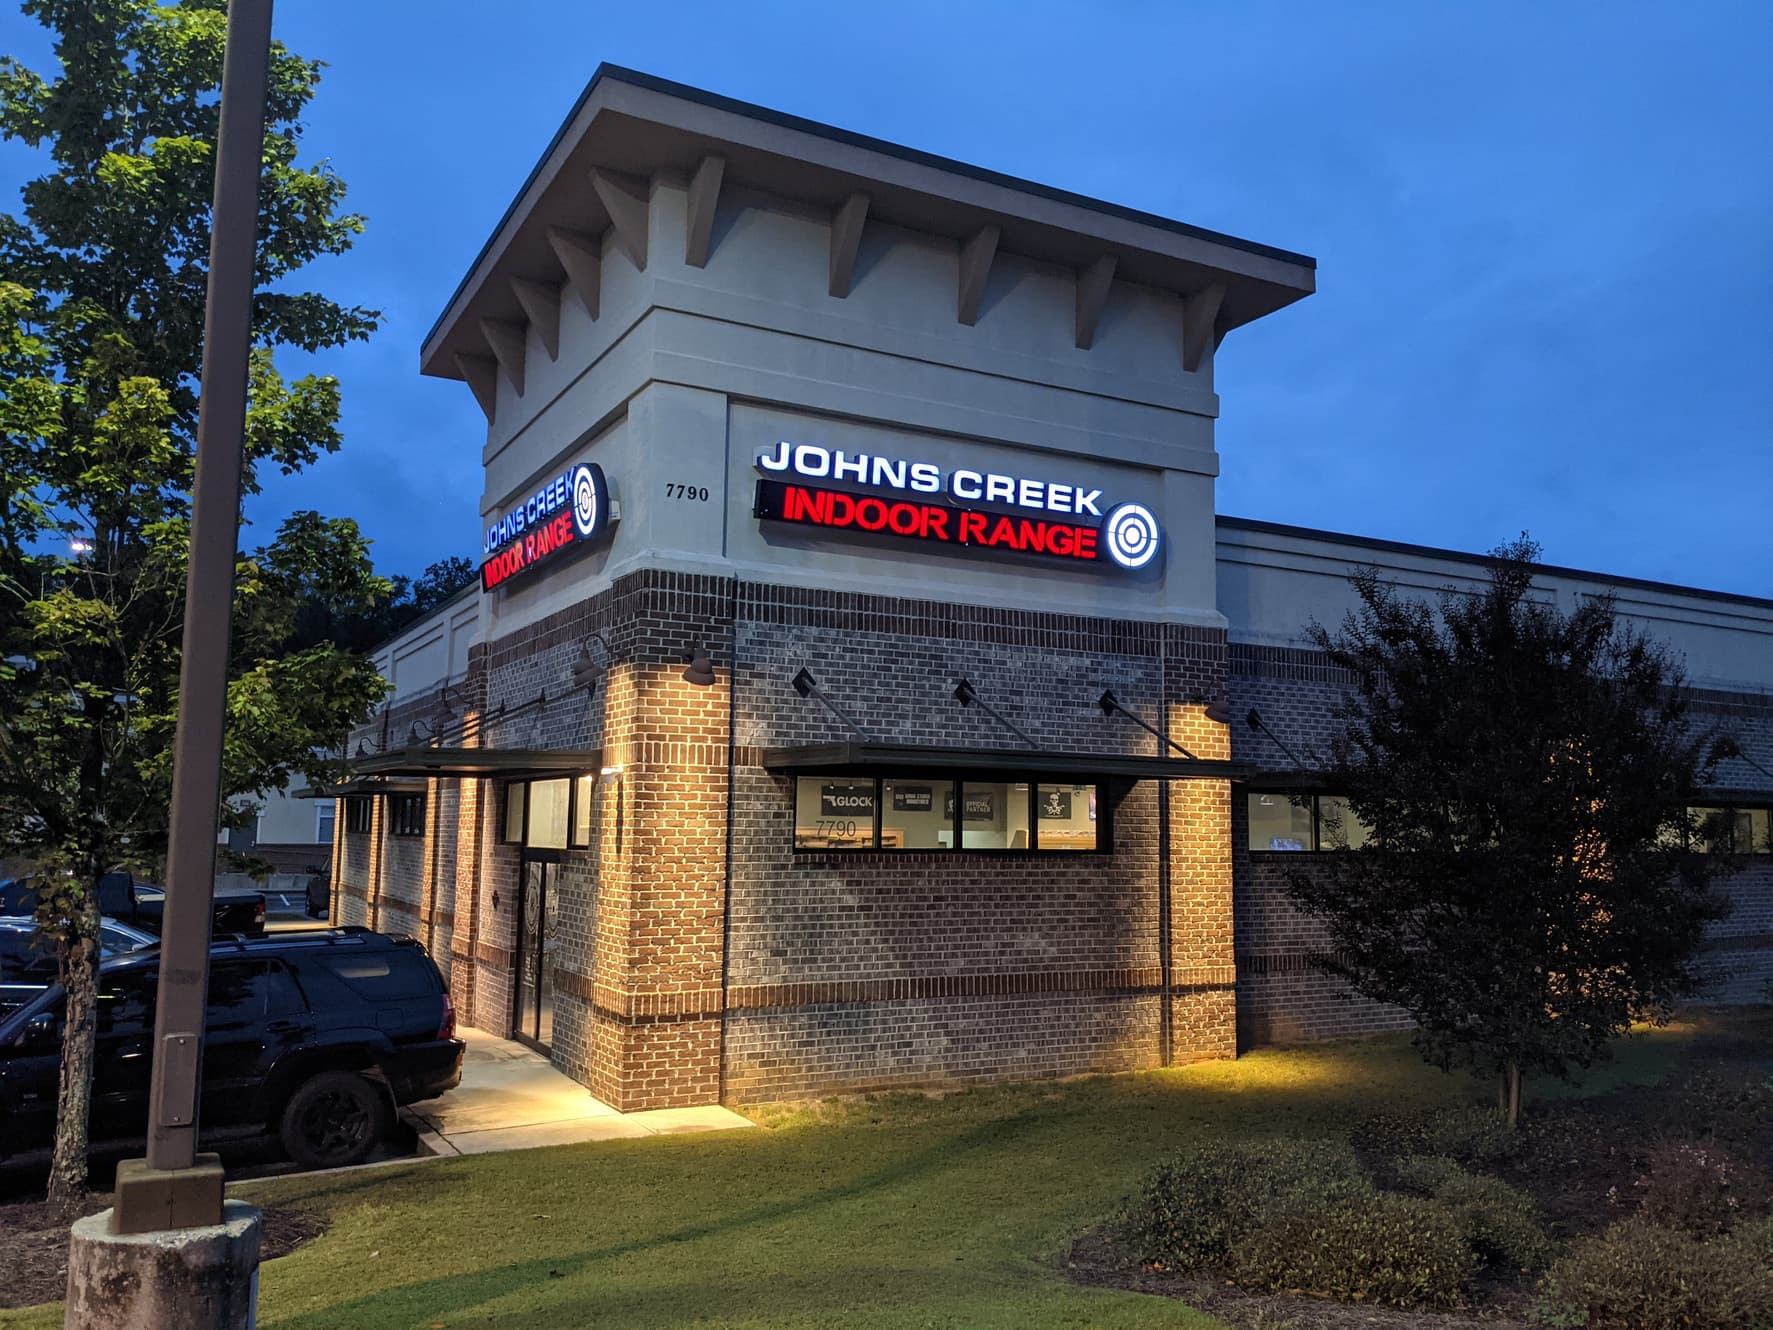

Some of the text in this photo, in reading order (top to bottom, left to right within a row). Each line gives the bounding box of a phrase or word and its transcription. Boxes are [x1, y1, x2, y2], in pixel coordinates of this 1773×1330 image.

[484, 467, 574, 554] JOHNS CREEK
[666, 483, 709, 502] 7790
[761, 441, 1104, 516] JOHNS CREEK
[485, 511, 573, 588] INDOOR RANGE
[783, 486, 1097, 559] INDOOR RANGE
[815, 820, 856, 837] 7790
[836, 796, 873, 807] GLOCK
